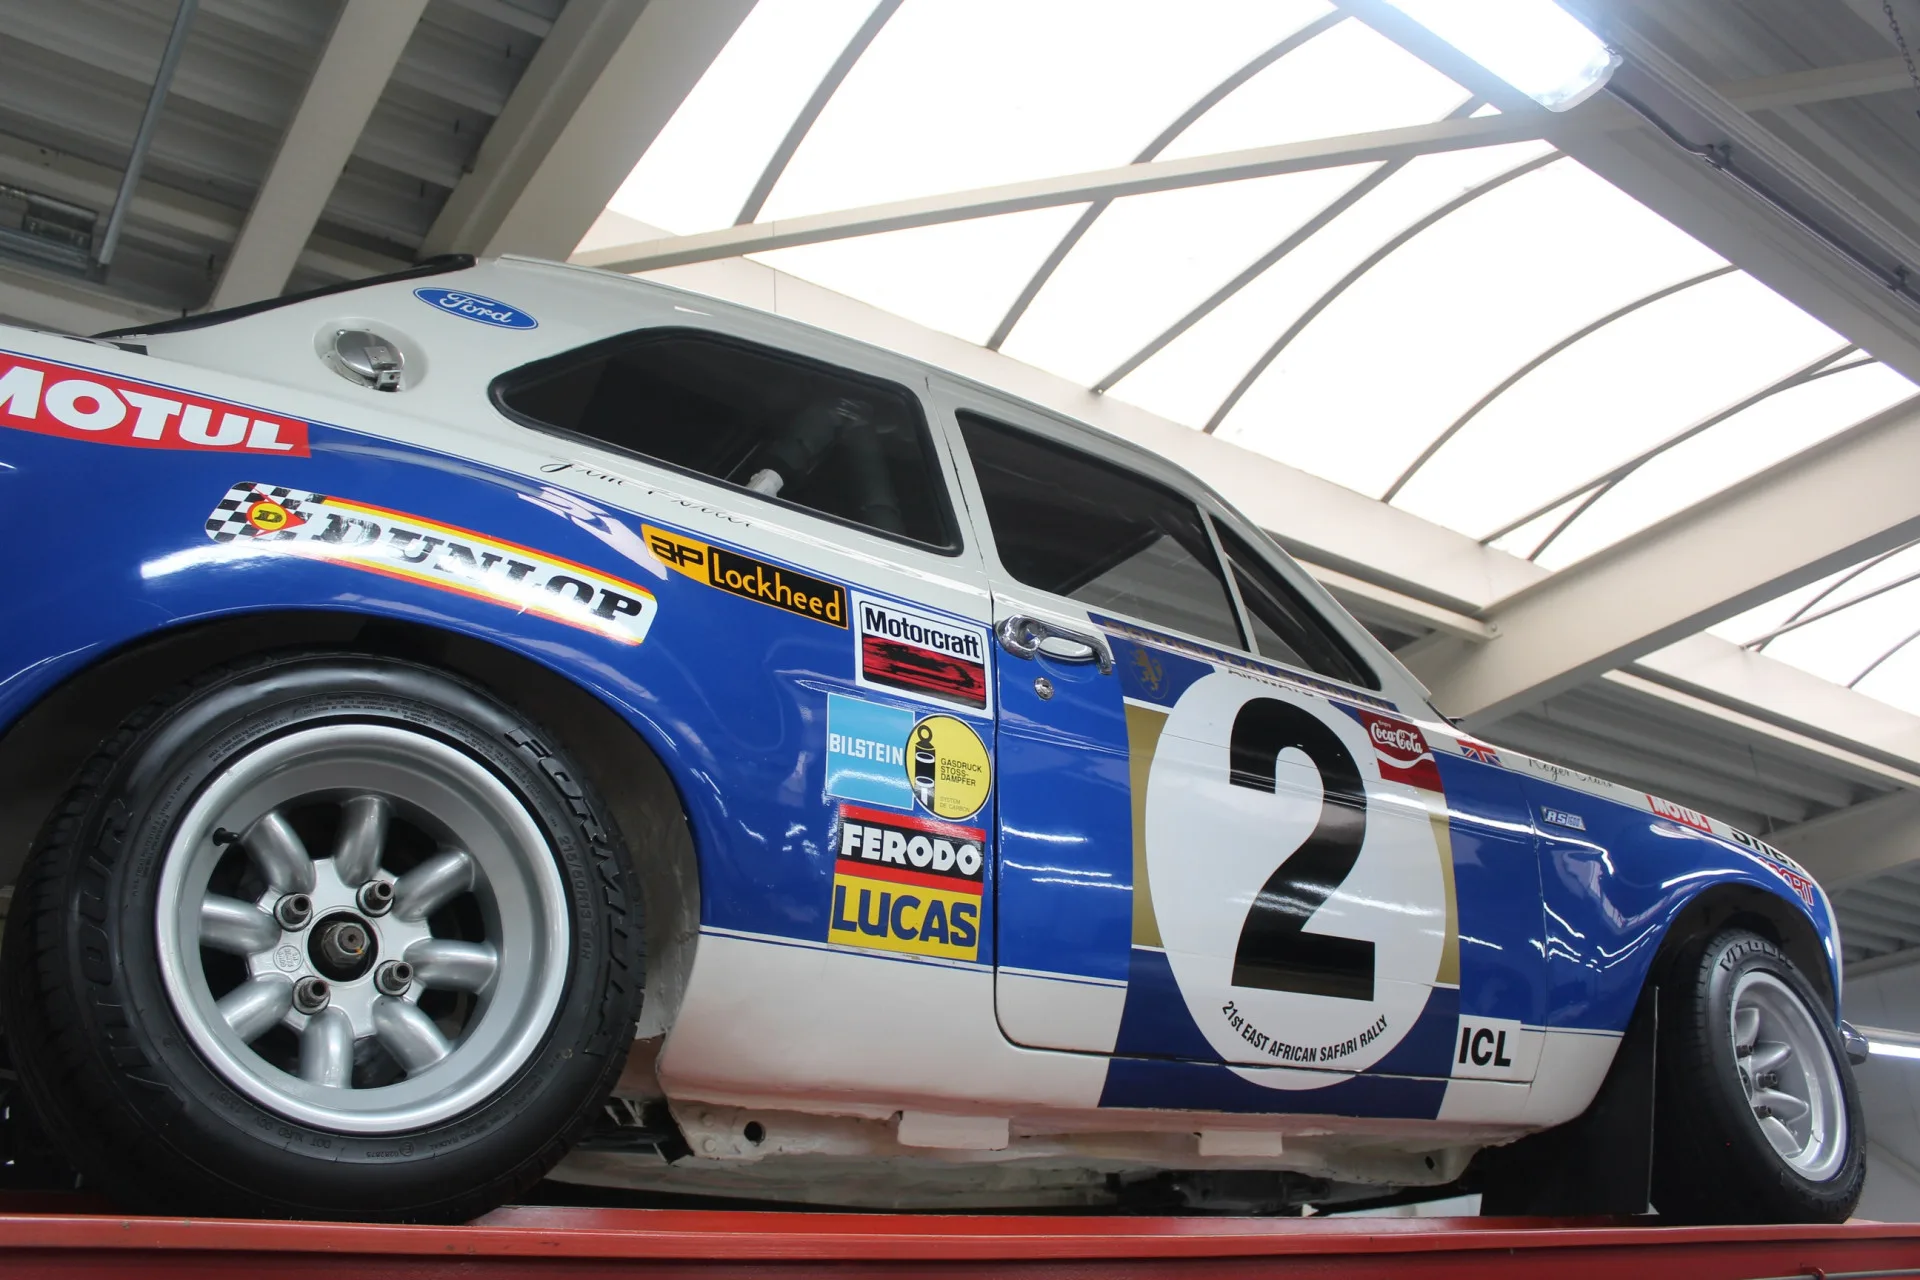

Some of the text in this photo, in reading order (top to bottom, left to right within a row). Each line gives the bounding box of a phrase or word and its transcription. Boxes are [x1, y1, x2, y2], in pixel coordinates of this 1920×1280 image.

[440, 292, 512, 323] Ford
[256, 509, 283, 523] D
[312, 513, 643, 622] DUNLOP
[712, 552, 841, 622] Lockheed
[865, 607, 981, 659] Motorcraft
[829, 732, 904, 767] BILSTEIN
[940, 757, 983, 774] GASDRUCK
[1547, 810, 1567, 824] RS
[1652, 796, 1709, 830] MOTUL
[840, 822, 982, 877] FERODO
[1230, 697, 1376, 1002] 2
[832, 884, 978, 948] LUCAS
[1221, 1000, 1388, 1063] 21st EAST AFRICAN SAFARI RALLY
[1458, 1026, 1511, 1067] ICL
